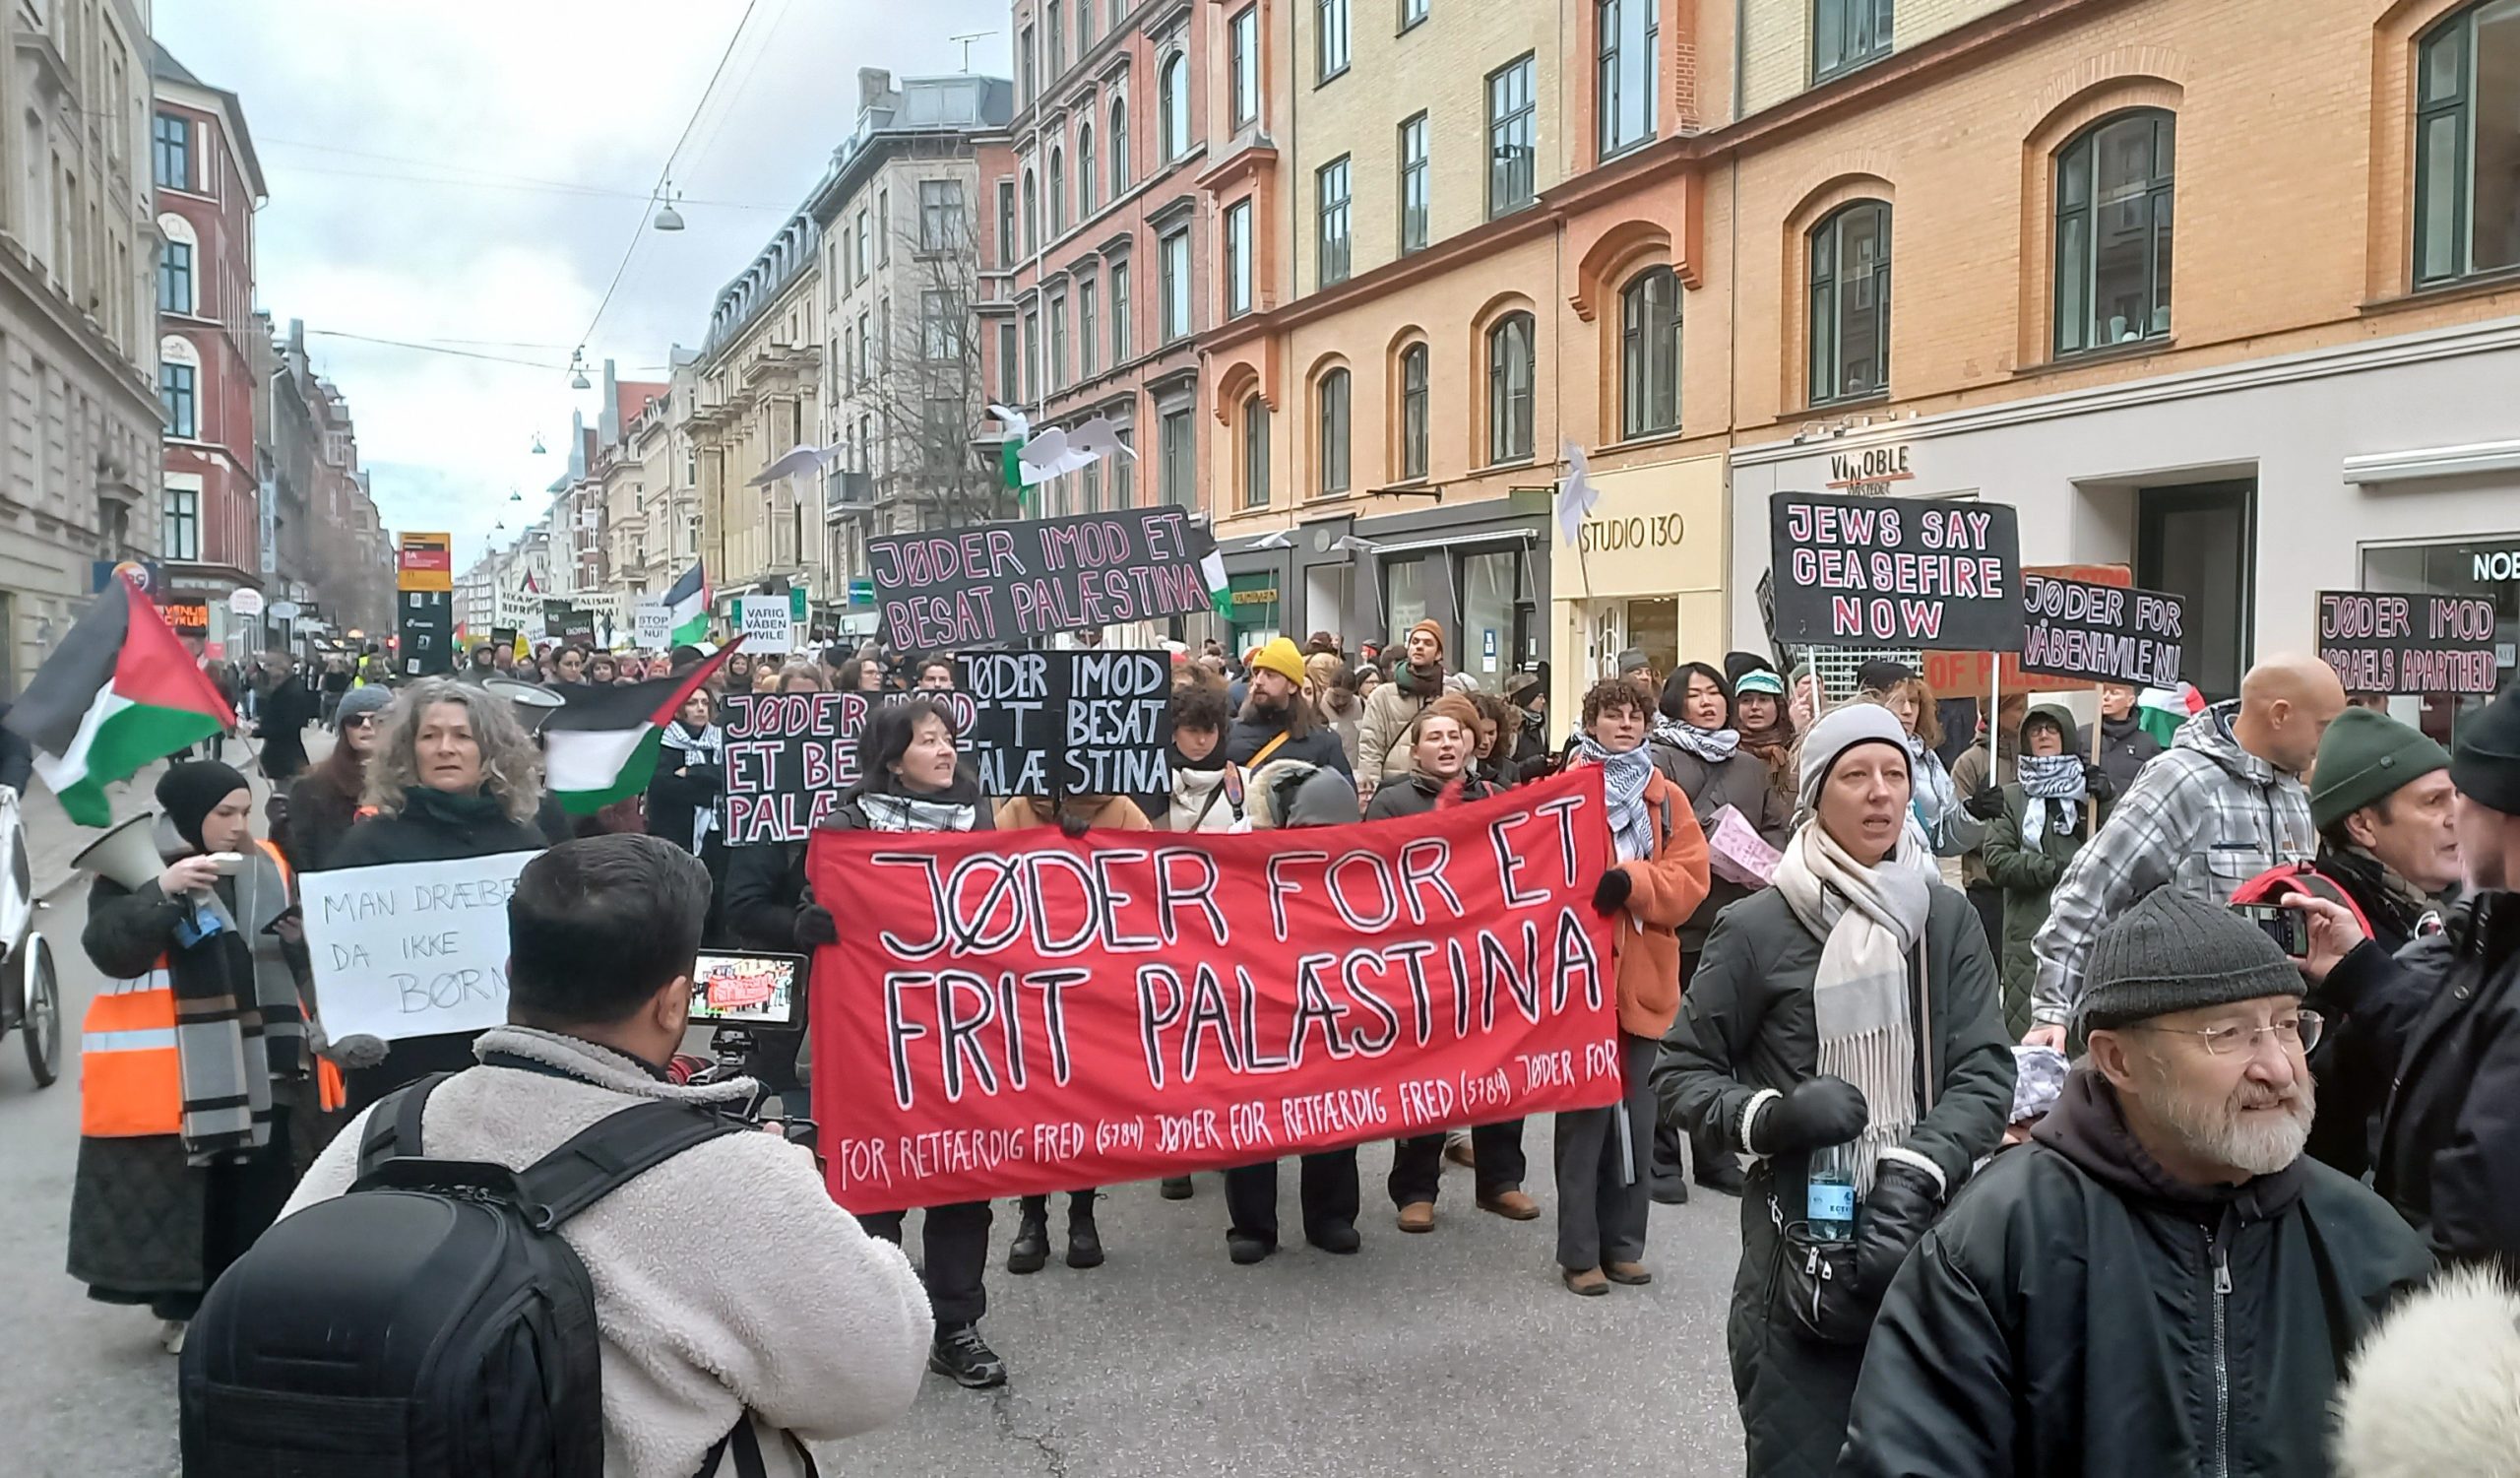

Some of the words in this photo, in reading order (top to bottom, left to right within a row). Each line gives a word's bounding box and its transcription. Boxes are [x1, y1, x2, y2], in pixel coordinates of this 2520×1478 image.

[1831, 446, 1910, 485] VINOBLE
[870, 530, 1026, 588] JØDER
[1039, 521, 1131, 571] IMOD
[1141, 513, 1186, 561] ET
[1581, 517, 1645, 552] STUDIO
[1650, 512, 1684, 547] 130
[1788, 504, 1902, 546] JEWS
[1922, 510, 1991, 550] SAY
[1793, 547, 2003, 599] CEASEFIRE
[639, 615, 668, 624] STOP
[745, 617, 787, 629] VÅBEN
[747, 608, 785, 618] VARIG
[886, 586, 995, 651] BESAT
[1010, 563, 1211, 634] PALÆSTINA
[1832, 595, 1943, 639] NOW
[2024, 577, 2124, 627] JØDER
[2136, 596, 2182, 638] FOR
[2322, 596, 2411, 639] JØDER
[2429, 598, 2494, 641] IMOD
[644, 629, 663, 638] NU!
[2024, 618, 2152, 682] VÅBENHVILE
[957, 654, 1048, 700] JØDER
[1071, 653, 1164, 697] IMOD
[1929, 653, 1967, 689] OF
[2401, 649, 2497, 693] APARTHEID
[727, 693, 869, 739] JØDER
[1066, 698, 1166, 746] BESAT
[725, 740, 785, 795] ET
[1064, 748, 1170, 795] STINA
[324, 890, 395, 924] MAN
[413, 877, 521, 912] DRÆBE
[871, 847, 1229, 961] JØDER
[1267, 837, 1466, 942] FOR
[1488, 795, 1586, 910] ET
[332, 943, 370, 972] DA
[403, 932, 460, 959] IKKE
[388, 967, 511, 1014] BØRN
[884, 968, 1091, 1111] FRIT
[1137, 905, 1603, 1090] PALÆSTINA
[841, 1137, 892, 1192] FOR
[900, 1127, 1025, 1181] RETFÆRDIG
[1034, 1123, 1085, 1164] FRED
[1096, 1115, 1145, 1155] (5784)
[1154, 1108, 1225, 1154] JØDER
[1229, 1101, 1274, 1150] FOR
[1281, 1087, 1388, 1142] RETFÆRDIG
[1399, 1078, 1454, 1127] FRED
[1460, 1067, 1511, 1116] (5784)
[1514, 1049, 1576, 1096] JØDER
[1585, 1038, 1621, 1084] FOR
